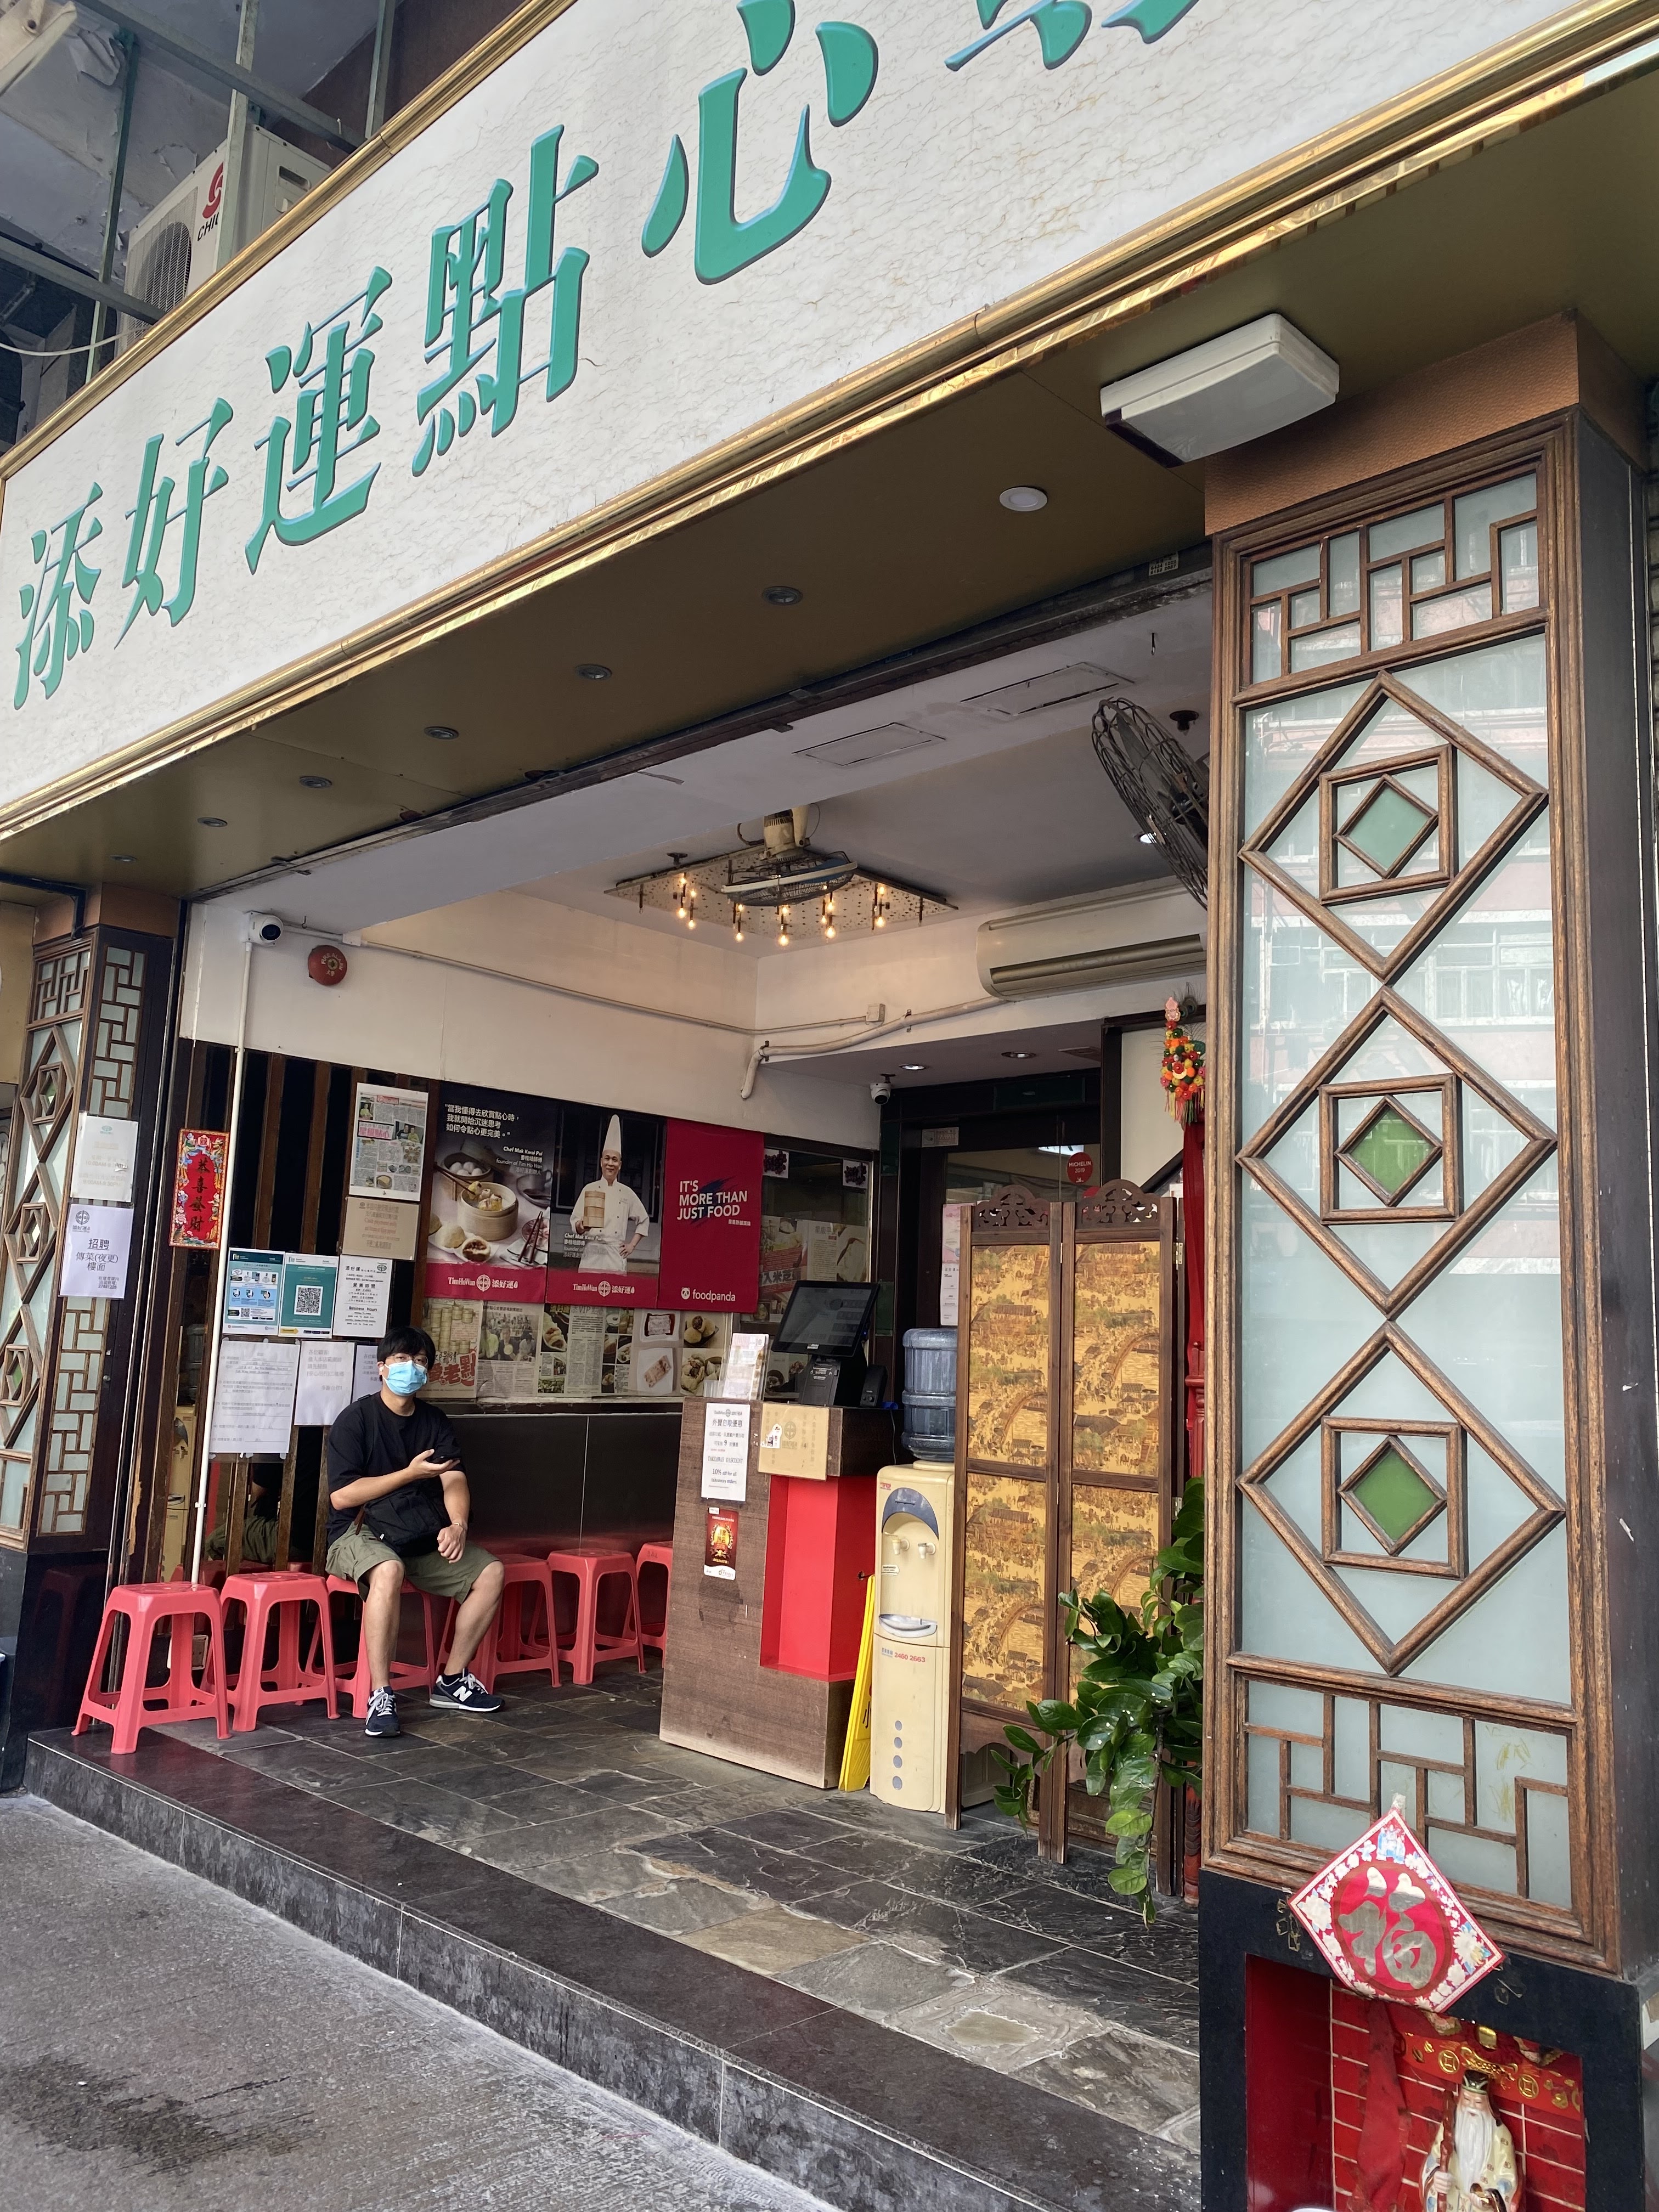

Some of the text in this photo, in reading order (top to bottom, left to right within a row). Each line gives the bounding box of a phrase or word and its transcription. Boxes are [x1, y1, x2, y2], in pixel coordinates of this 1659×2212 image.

[14, 0, 1200, 710] 添好運點心
[321, 952, 344, 971] FIRE ALARM
[680, 1180, 699, 1193] IT'S
[679, 1190, 748, 1206] MORE THAN
[676, 1204, 741, 1221] JUST FOOD
[88, 1238, 110, 1250] 招聘
[87, 1261, 106, 1272] 樓面
[448, 1277, 476, 1286] TimHoWan
[572, 1283, 597, 1292] TimHoWan
[692, 1289, 736, 1304] foodpanda
[712, 1418, 743, 1428] 外賣自取優惠
[894, 1652, 909, 1660] 2460
[1338, 1865, 1437, 1990] 福
